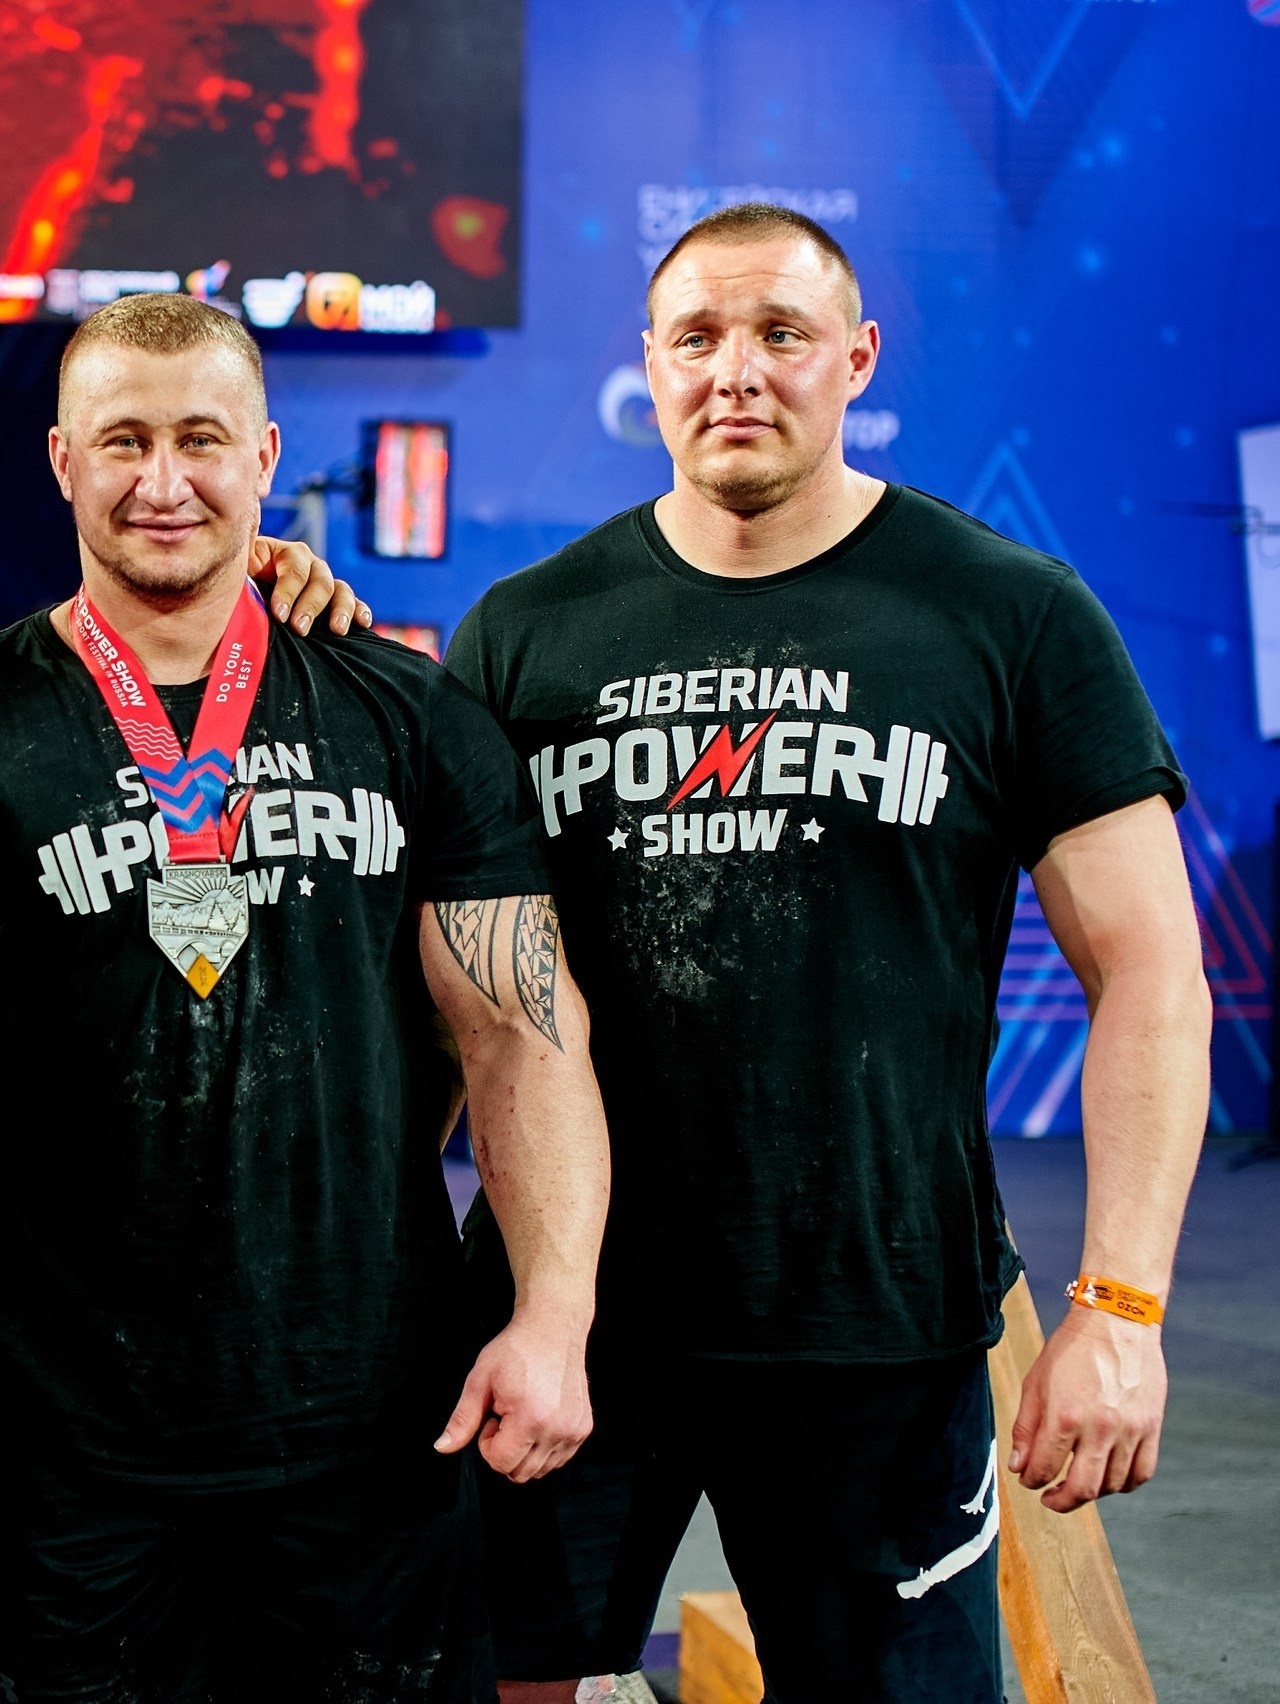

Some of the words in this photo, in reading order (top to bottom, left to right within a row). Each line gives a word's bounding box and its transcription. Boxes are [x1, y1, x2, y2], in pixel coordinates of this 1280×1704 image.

[80, 604, 119, 661] POWER
[111, 660, 147, 707] SHOW
[87, 642, 109, 670] FESTIVAL
[223, 642, 243, 677] YOUR
[105, 670, 115, 678] IN
[235, 659, 253, 689] BEST
[109, 679, 129, 707] RUSSIA
[216, 682, 231, 703] DO
[595, 667, 850, 725] SIBERIAN
[116, 742, 314, 809] SIAN
[563, 712, 869, 816] POWER
[642, 808, 788, 858] SHOW
[168, 869, 227, 879] KRASNOYARSK
[1117, 1301, 1146, 1317] OZON
